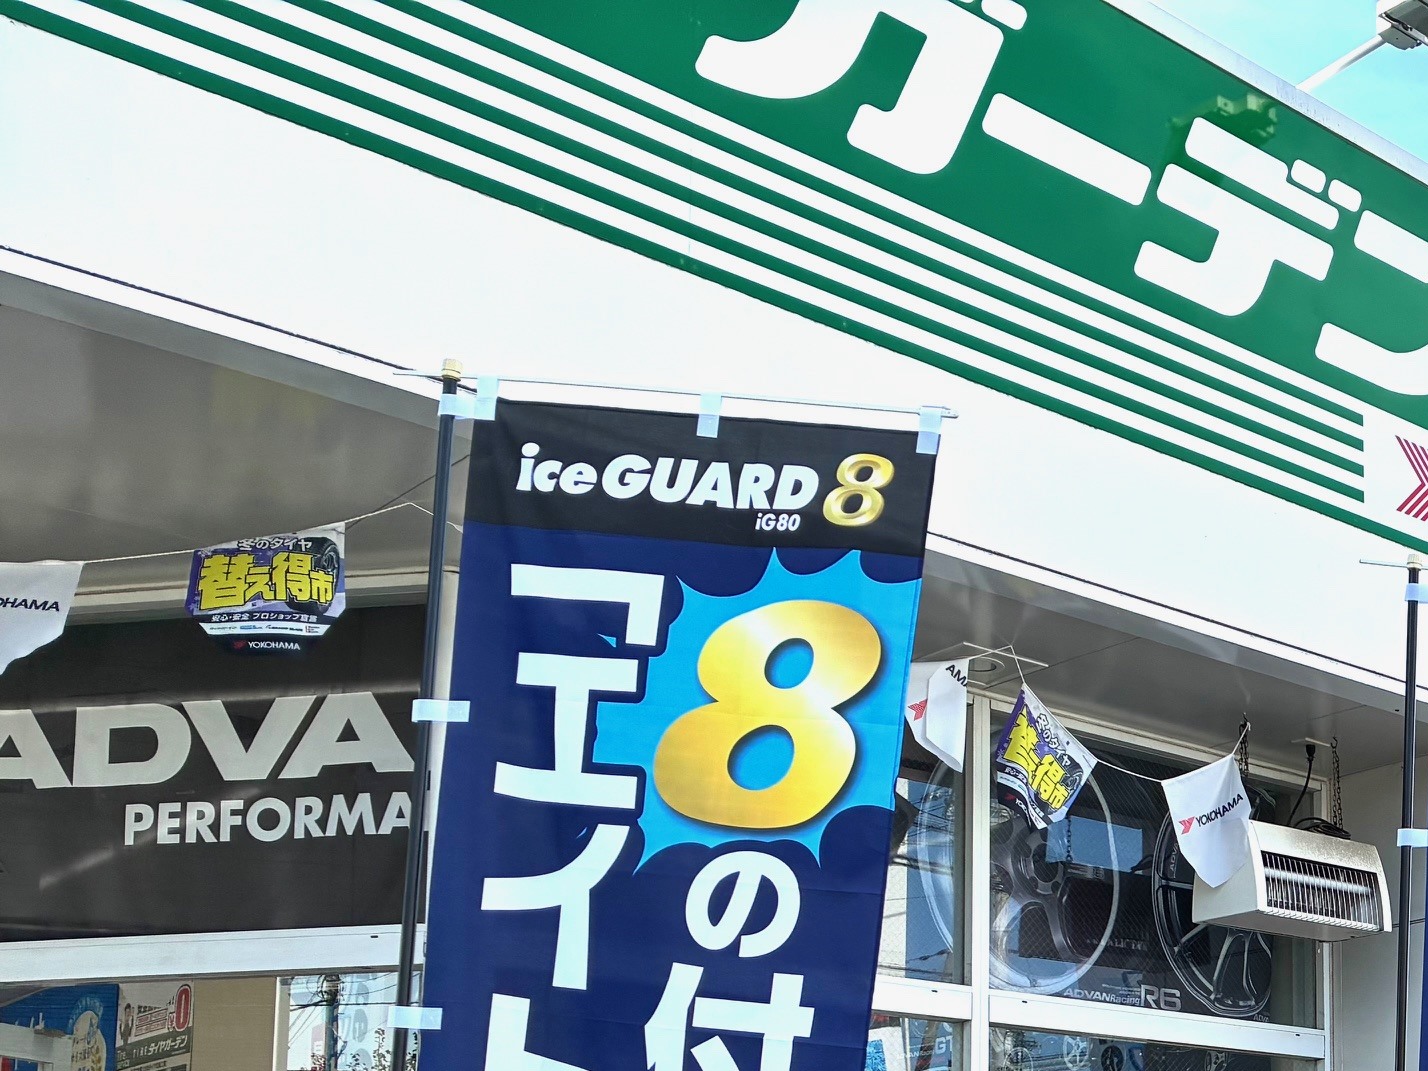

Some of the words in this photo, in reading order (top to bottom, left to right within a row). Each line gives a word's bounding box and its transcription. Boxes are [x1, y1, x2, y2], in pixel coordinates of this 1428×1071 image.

[515, 442, 820, 511] iceGUARD
[755, 512, 801, 532] iG80
[238, 537, 312, 551] 冬のタイヤ
[198, 551, 334, 611] 替え得市
[248, 640, 300, 650] YOKOHAMA
[1195, 793, 1243, 827] YOKOHAMA
[1140, 984, 1182, 1011] R6
